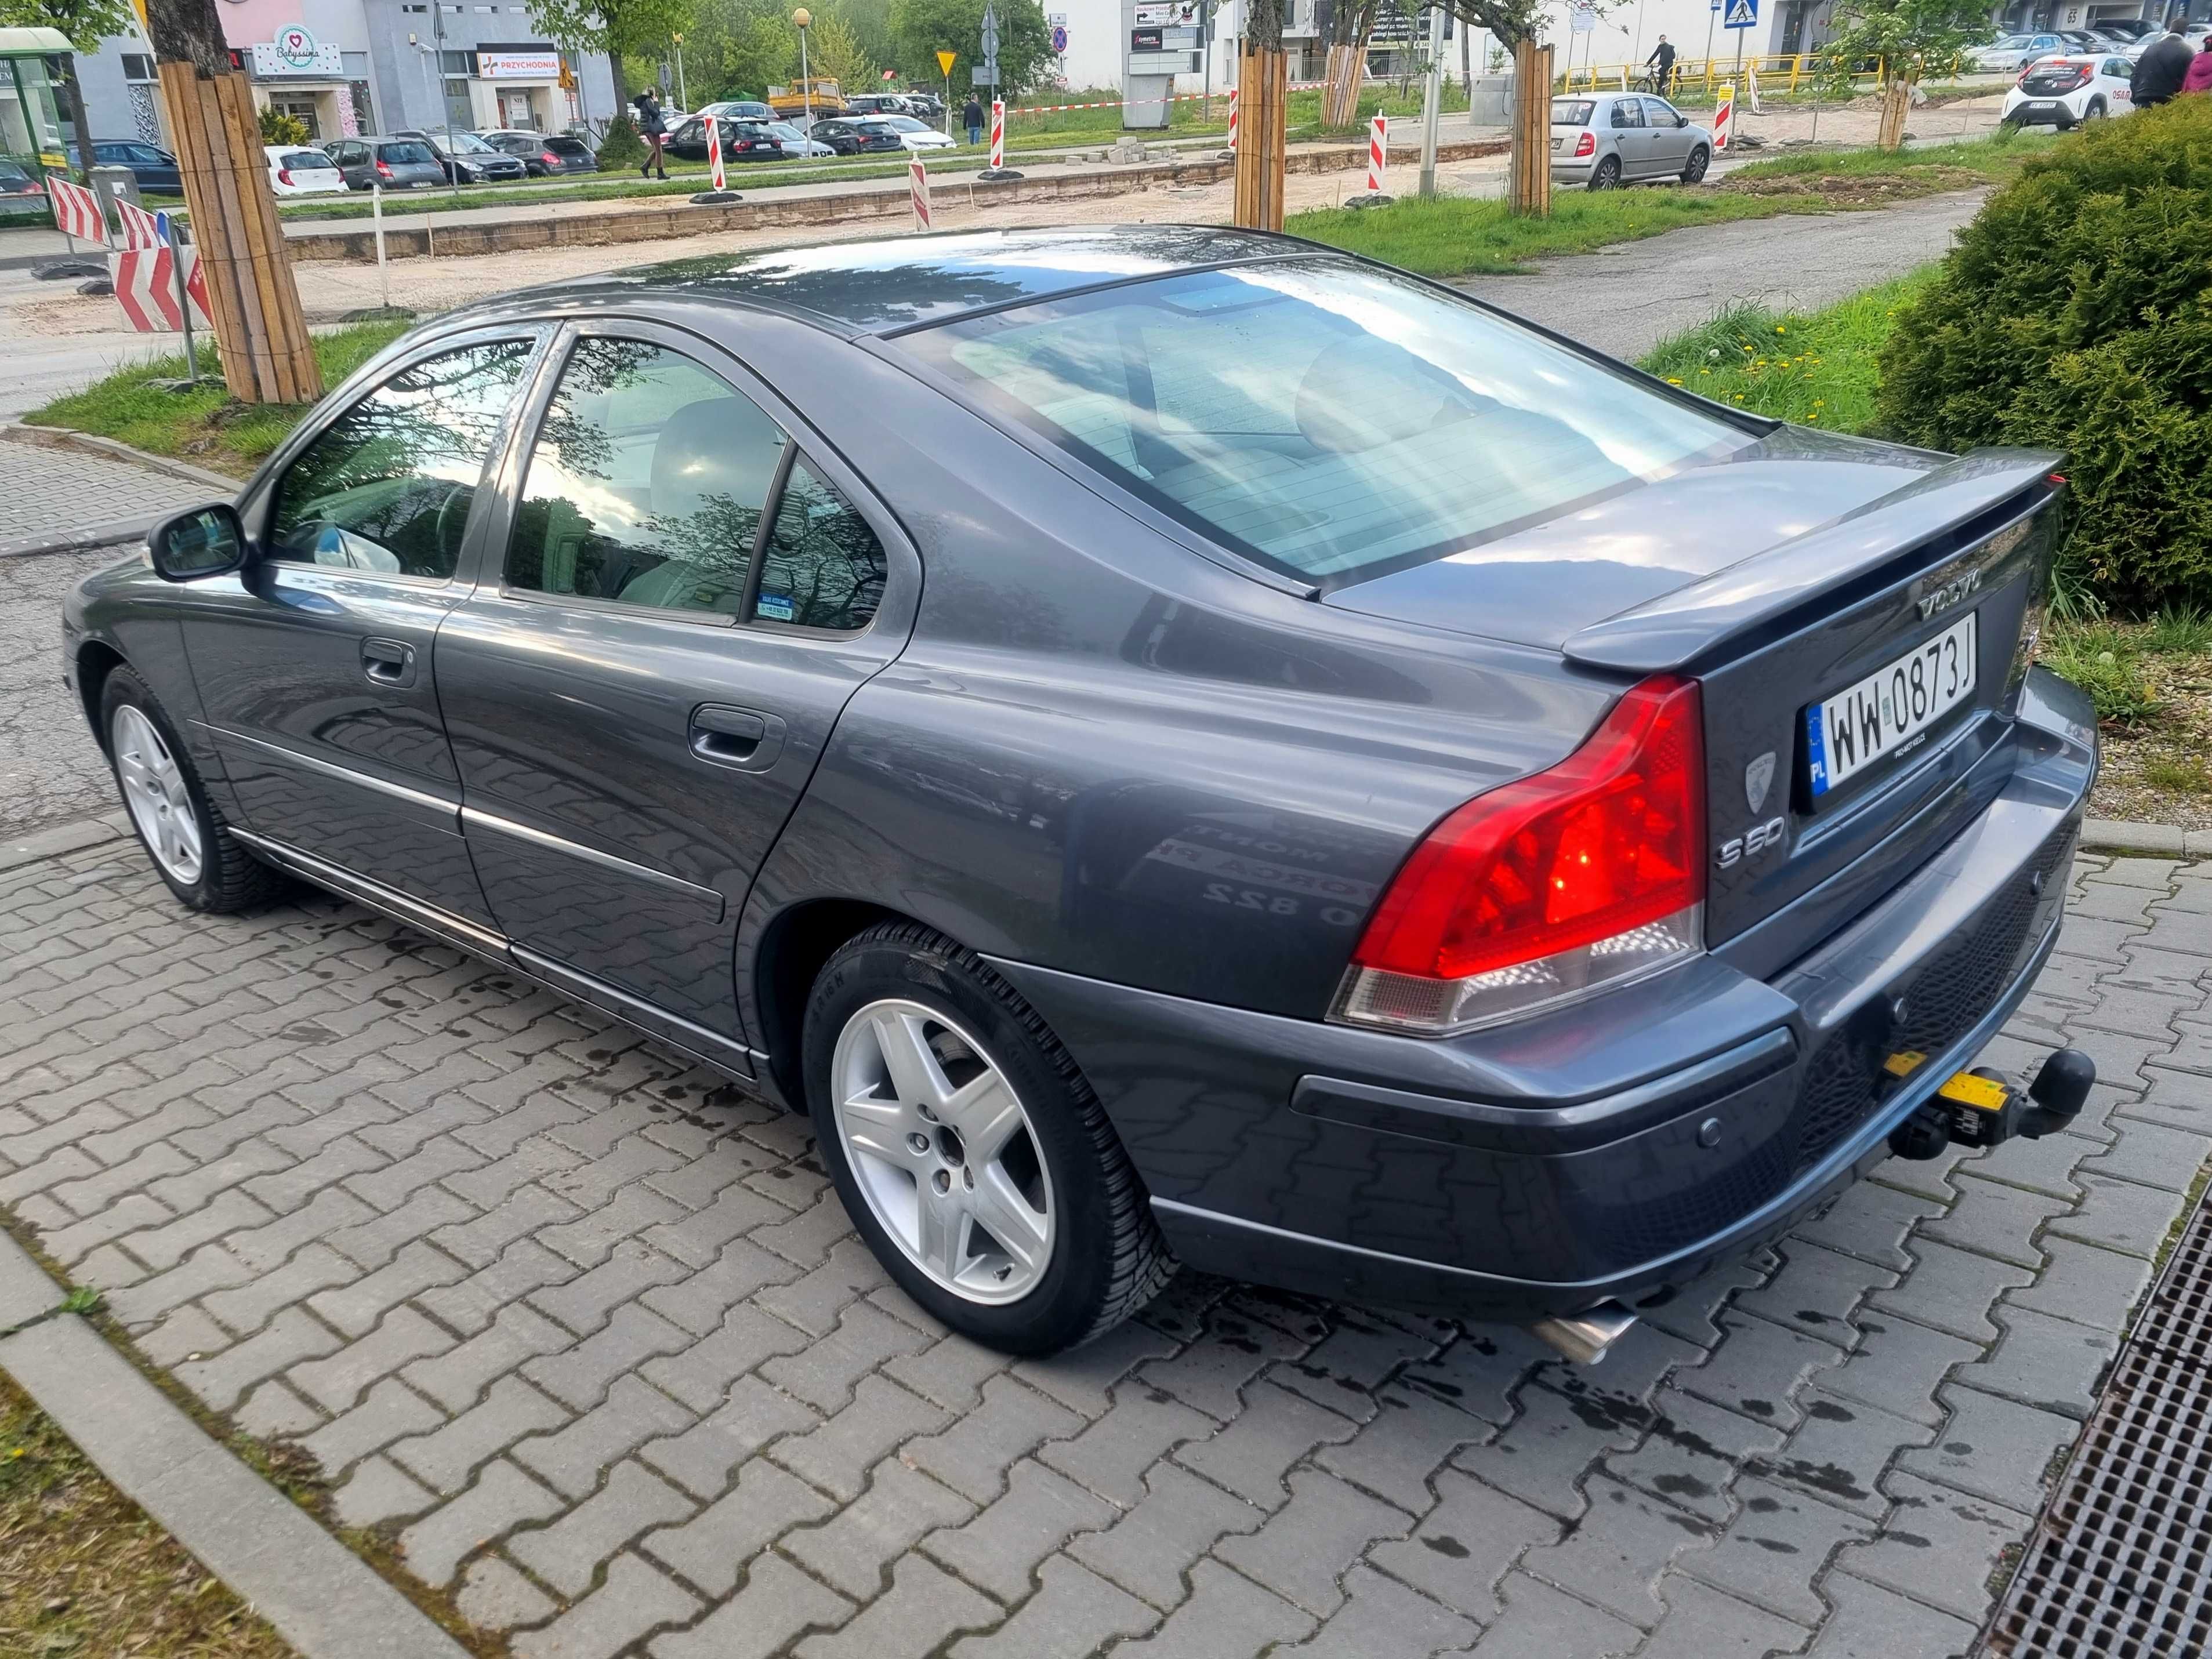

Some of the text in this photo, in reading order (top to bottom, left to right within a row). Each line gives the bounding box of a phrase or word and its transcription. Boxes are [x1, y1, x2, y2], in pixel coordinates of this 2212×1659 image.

[2068, 11, 2077, 24] 65
[275, 46, 320, 62] Babyssima
[1917, 568, 1982, 621] VOLVO
[1829, 622, 1971, 775] WW 0873J
[1810, 763, 1826, 783] PL
[1714, 816, 1785, 869] S60
